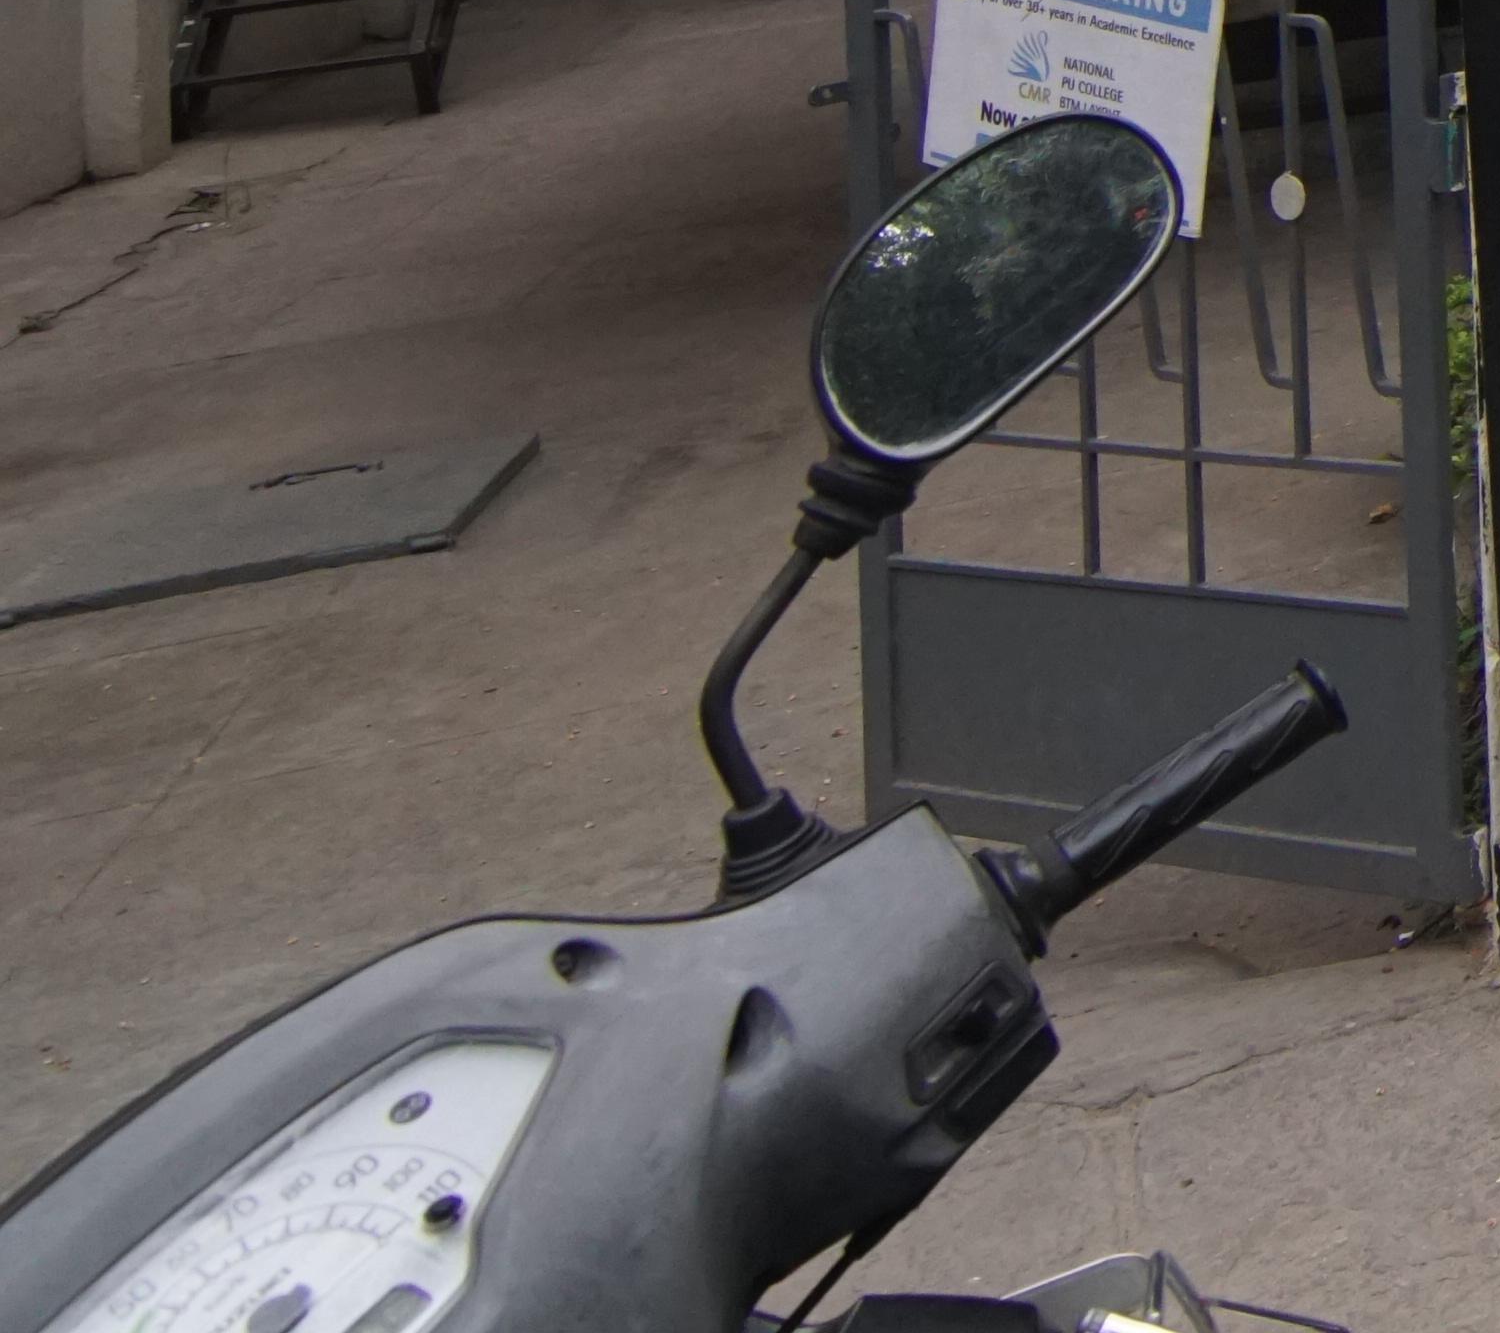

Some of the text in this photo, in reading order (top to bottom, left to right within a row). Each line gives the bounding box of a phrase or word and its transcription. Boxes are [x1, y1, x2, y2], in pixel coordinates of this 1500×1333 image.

[1049, 6, 1075, 24] years
[1076, 10, 1087, 26] in
[1089, 14, 1139, 38] Academic
[1141, 27, 1196, 51] Excellence
[1063, 56, 1115, 82] NATIONAL
[1019, 82, 1052, 104] CMR
[1061, 76, 1125, 104] PU COLLEGE
[981, 100, 1018, 128] Now
[333, 1153, 380, 1190] 90
[415, 1168, 463, 1204] 110
